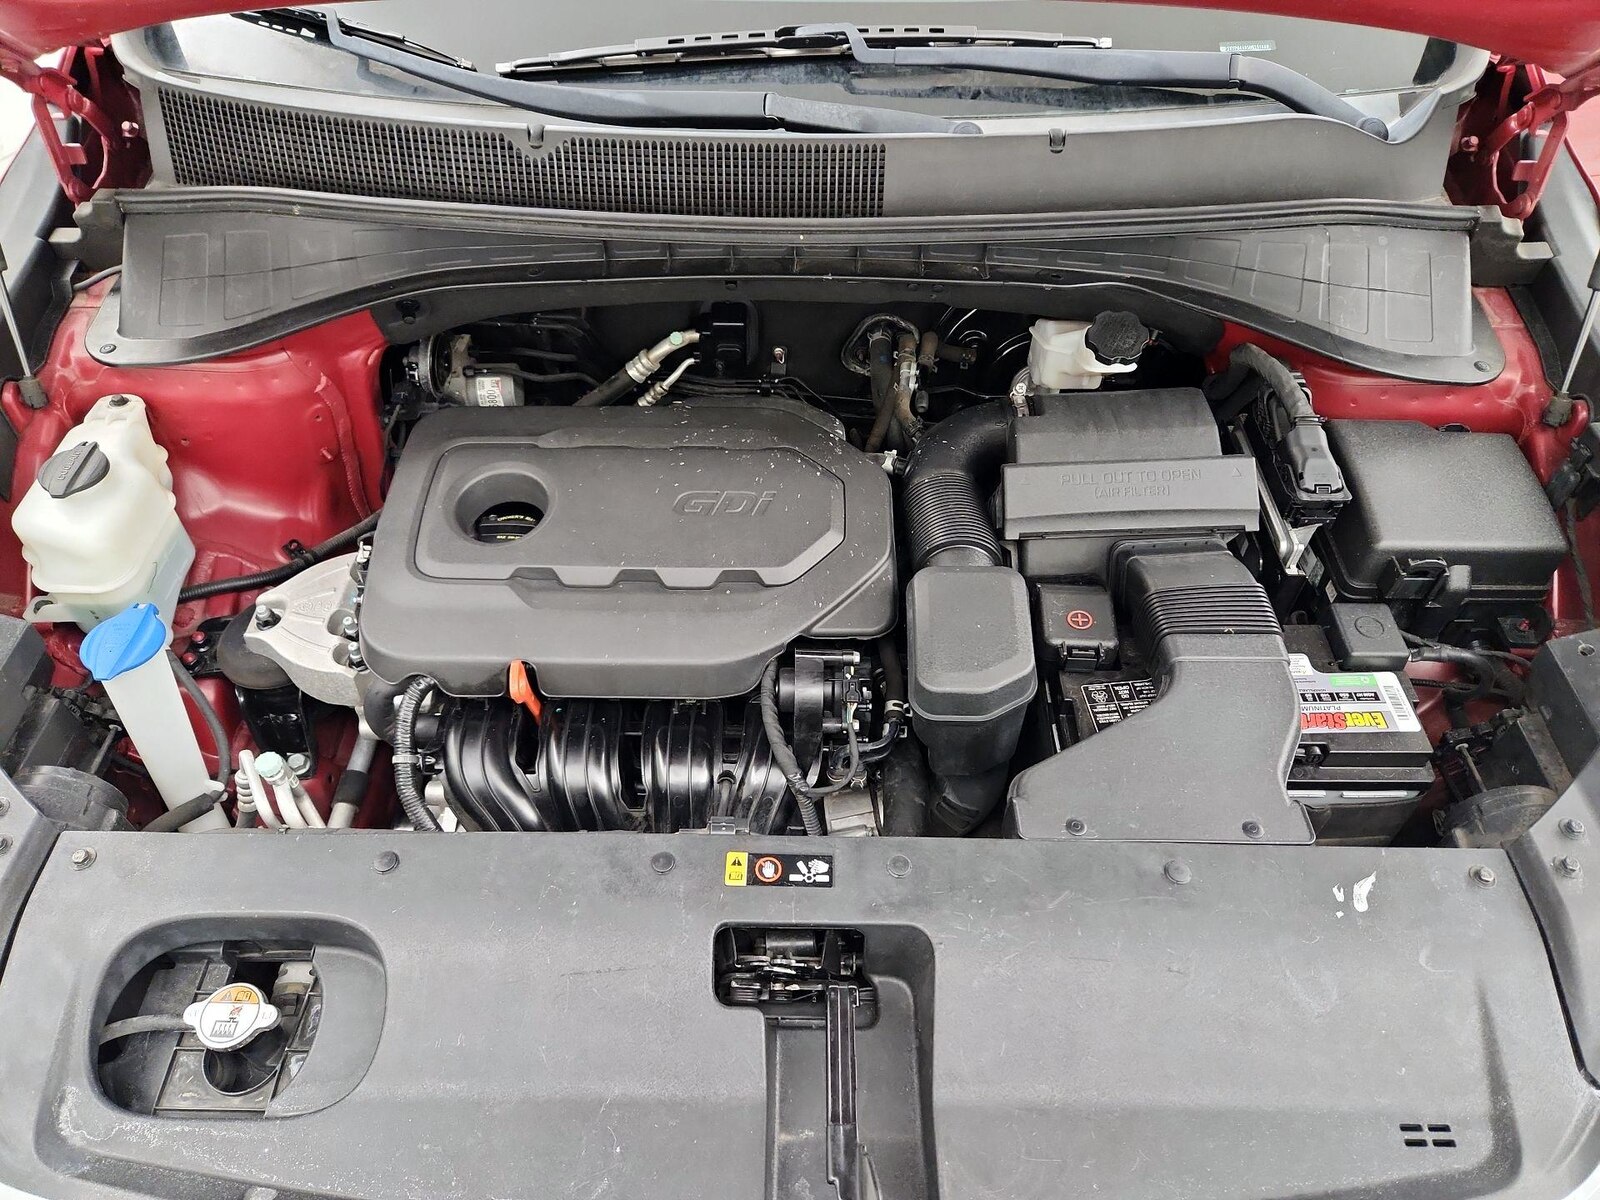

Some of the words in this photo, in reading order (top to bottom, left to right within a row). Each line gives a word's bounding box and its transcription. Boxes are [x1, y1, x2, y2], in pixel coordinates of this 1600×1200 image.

[1060, 473, 1098, 486] PULL
[1103, 471, 1132, 484] OUT
[1138, 470, 1157, 482] TO
[1161, 468, 1201, 481] OPEN
[672, 490, 777, 516] GDi
[1301, 712, 1388, 729] EverStart
